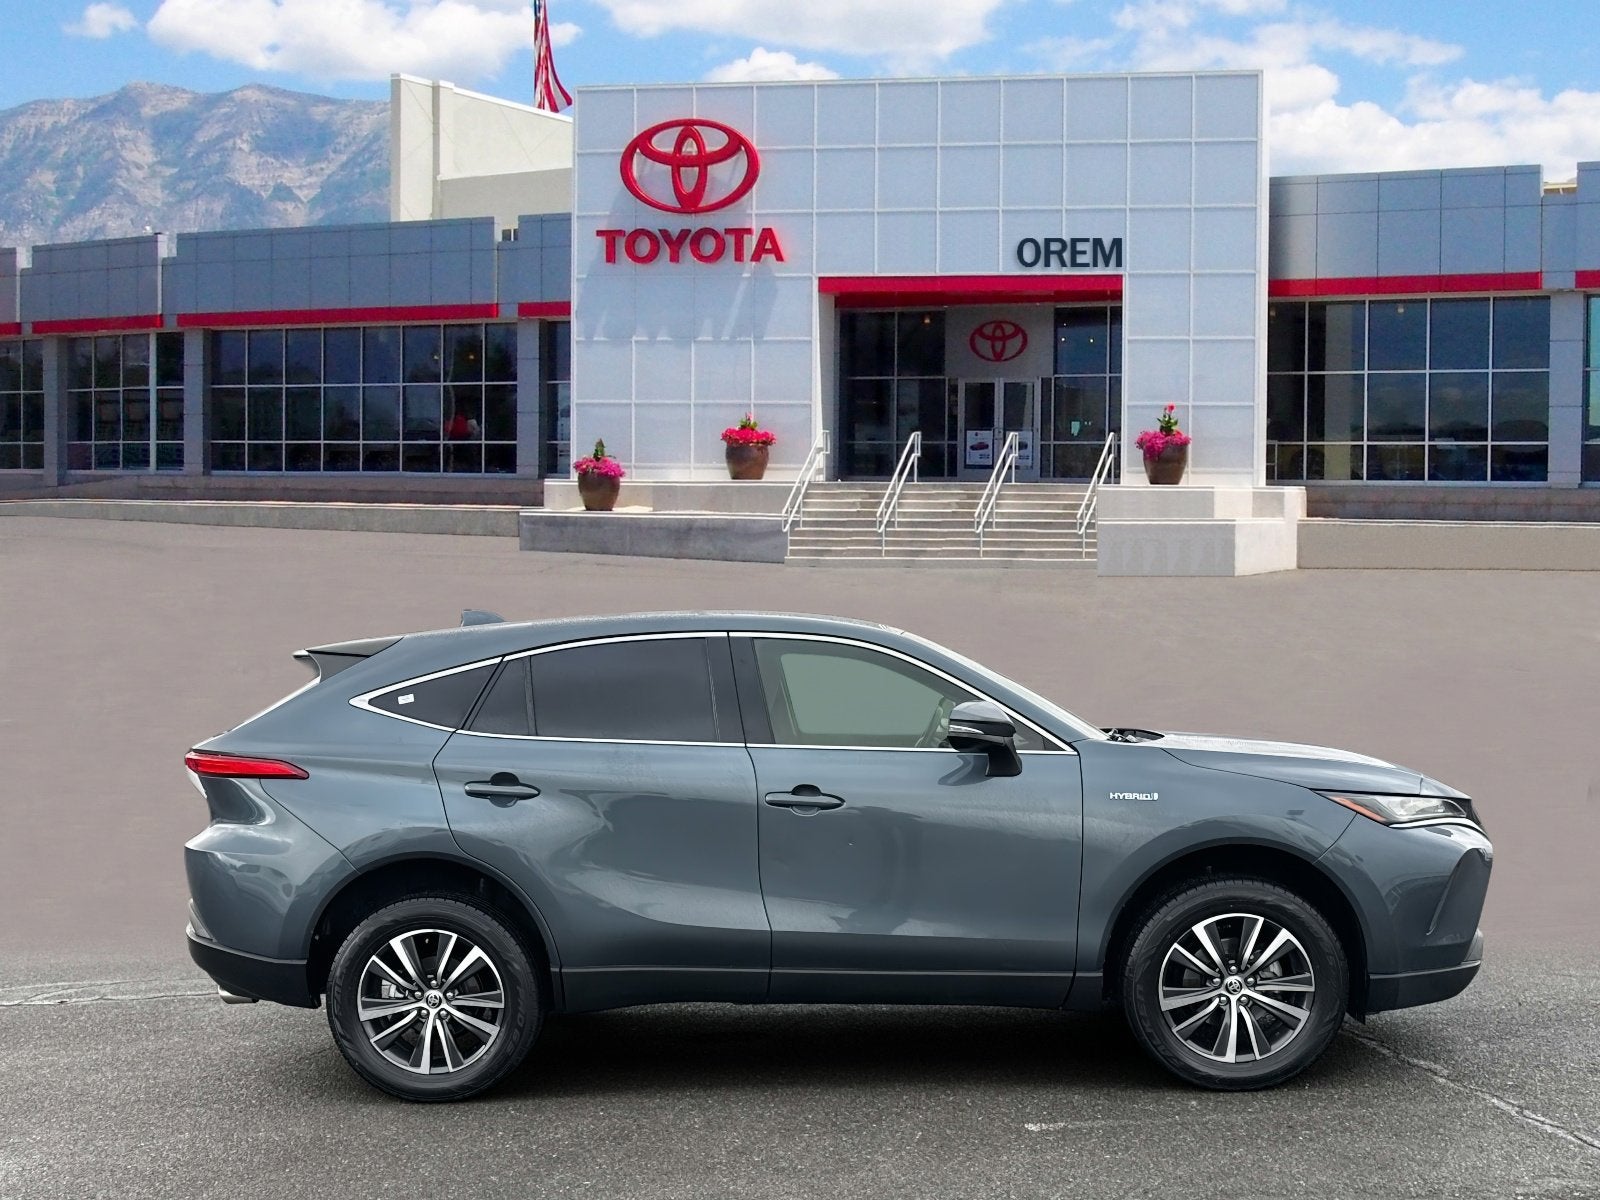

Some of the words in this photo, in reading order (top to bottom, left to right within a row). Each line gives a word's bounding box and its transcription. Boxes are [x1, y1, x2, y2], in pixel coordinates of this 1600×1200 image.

[596, 227, 784, 264] TOYOTA
[1016, 237, 1123, 268] OREM
[1109, 792, 1153, 801] HYBRID
